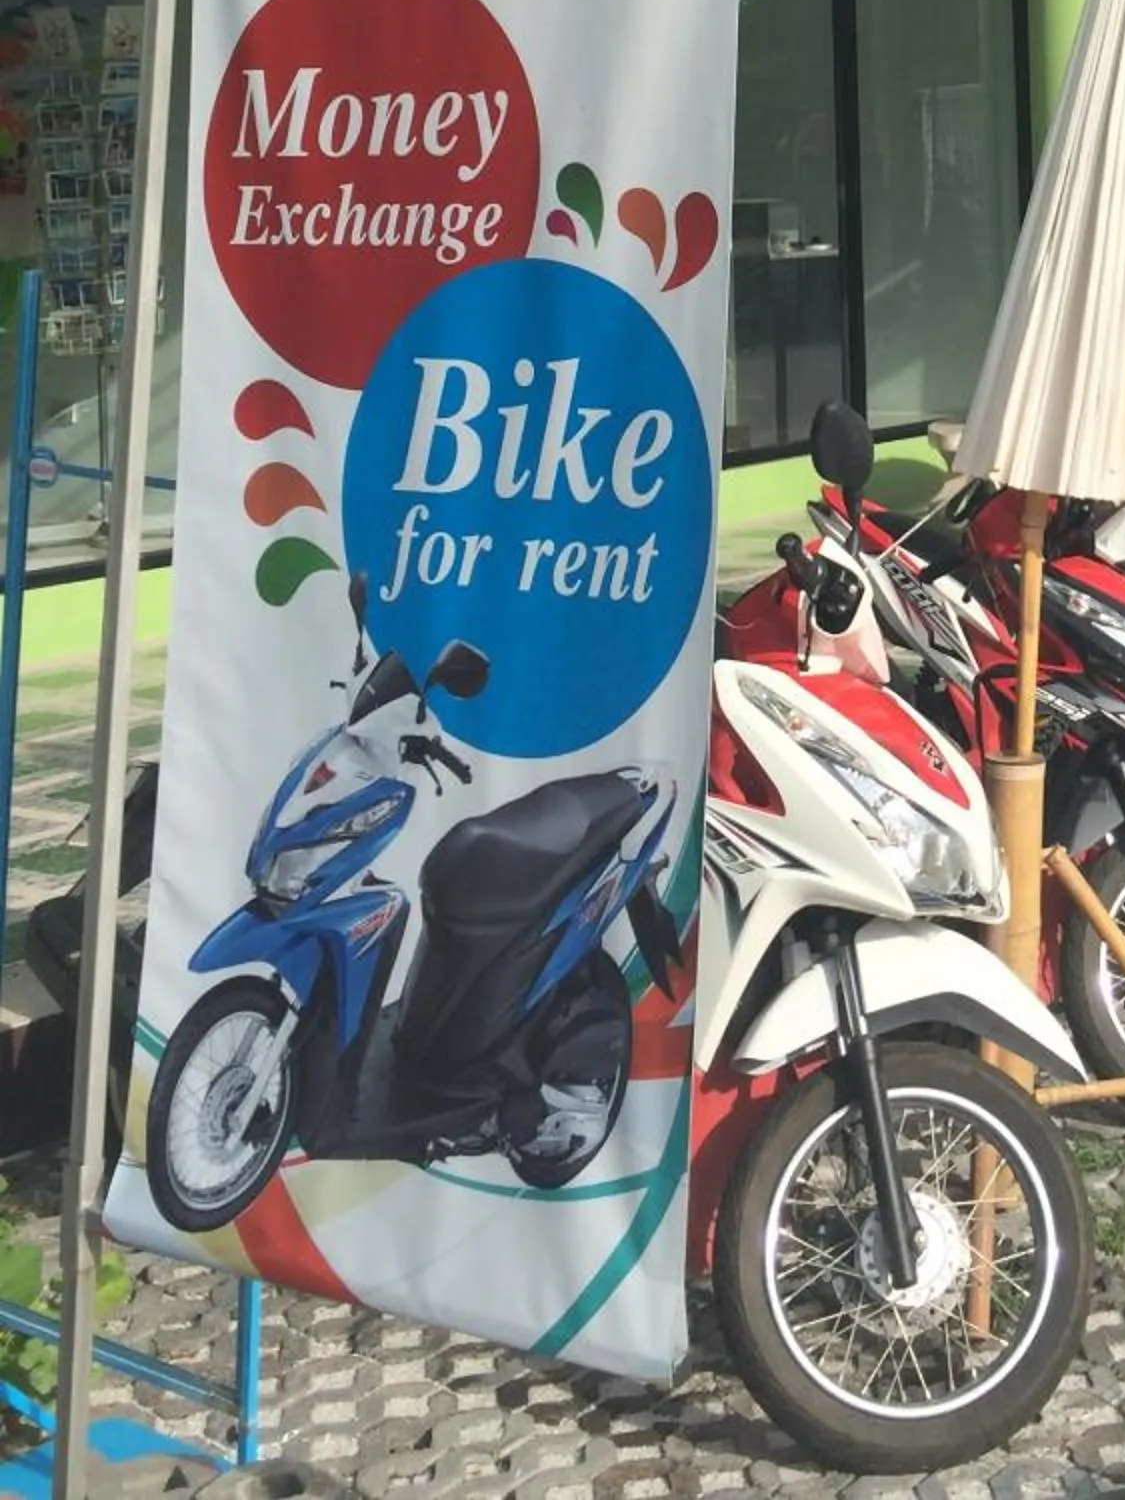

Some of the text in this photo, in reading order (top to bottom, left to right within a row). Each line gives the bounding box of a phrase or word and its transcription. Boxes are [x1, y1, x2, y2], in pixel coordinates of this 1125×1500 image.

[231, 66, 509, 182] Money
[229, 183, 503, 265] Exchange
[391, 357, 674, 509] Bike
[379, 504, 660, 603] for rent
